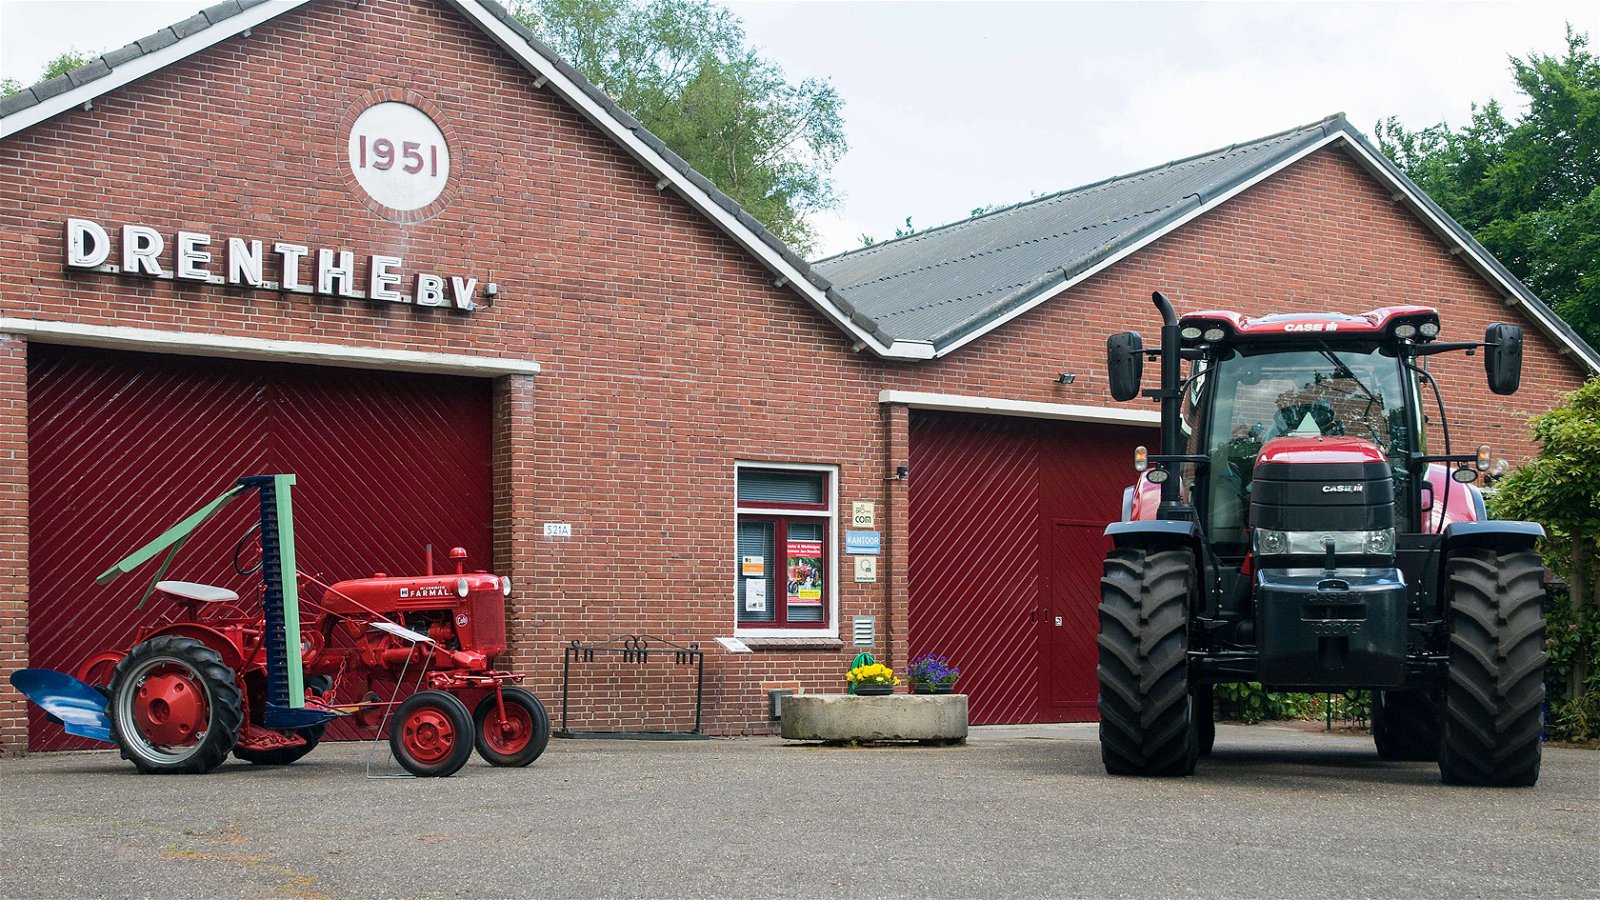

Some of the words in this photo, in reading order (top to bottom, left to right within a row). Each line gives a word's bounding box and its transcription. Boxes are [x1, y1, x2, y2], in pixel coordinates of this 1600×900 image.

[359, 134, 438, 177] 1951
[65, 217, 402, 300] DRENTHE
[413, 272, 478, 311] BV
[1284, 323, 1323, 332] CASE
[547, 525, 569, 535] 521A
[848, 536, 879, 545] KANTOOR
[410, 589, 453, 597] FARMAL
